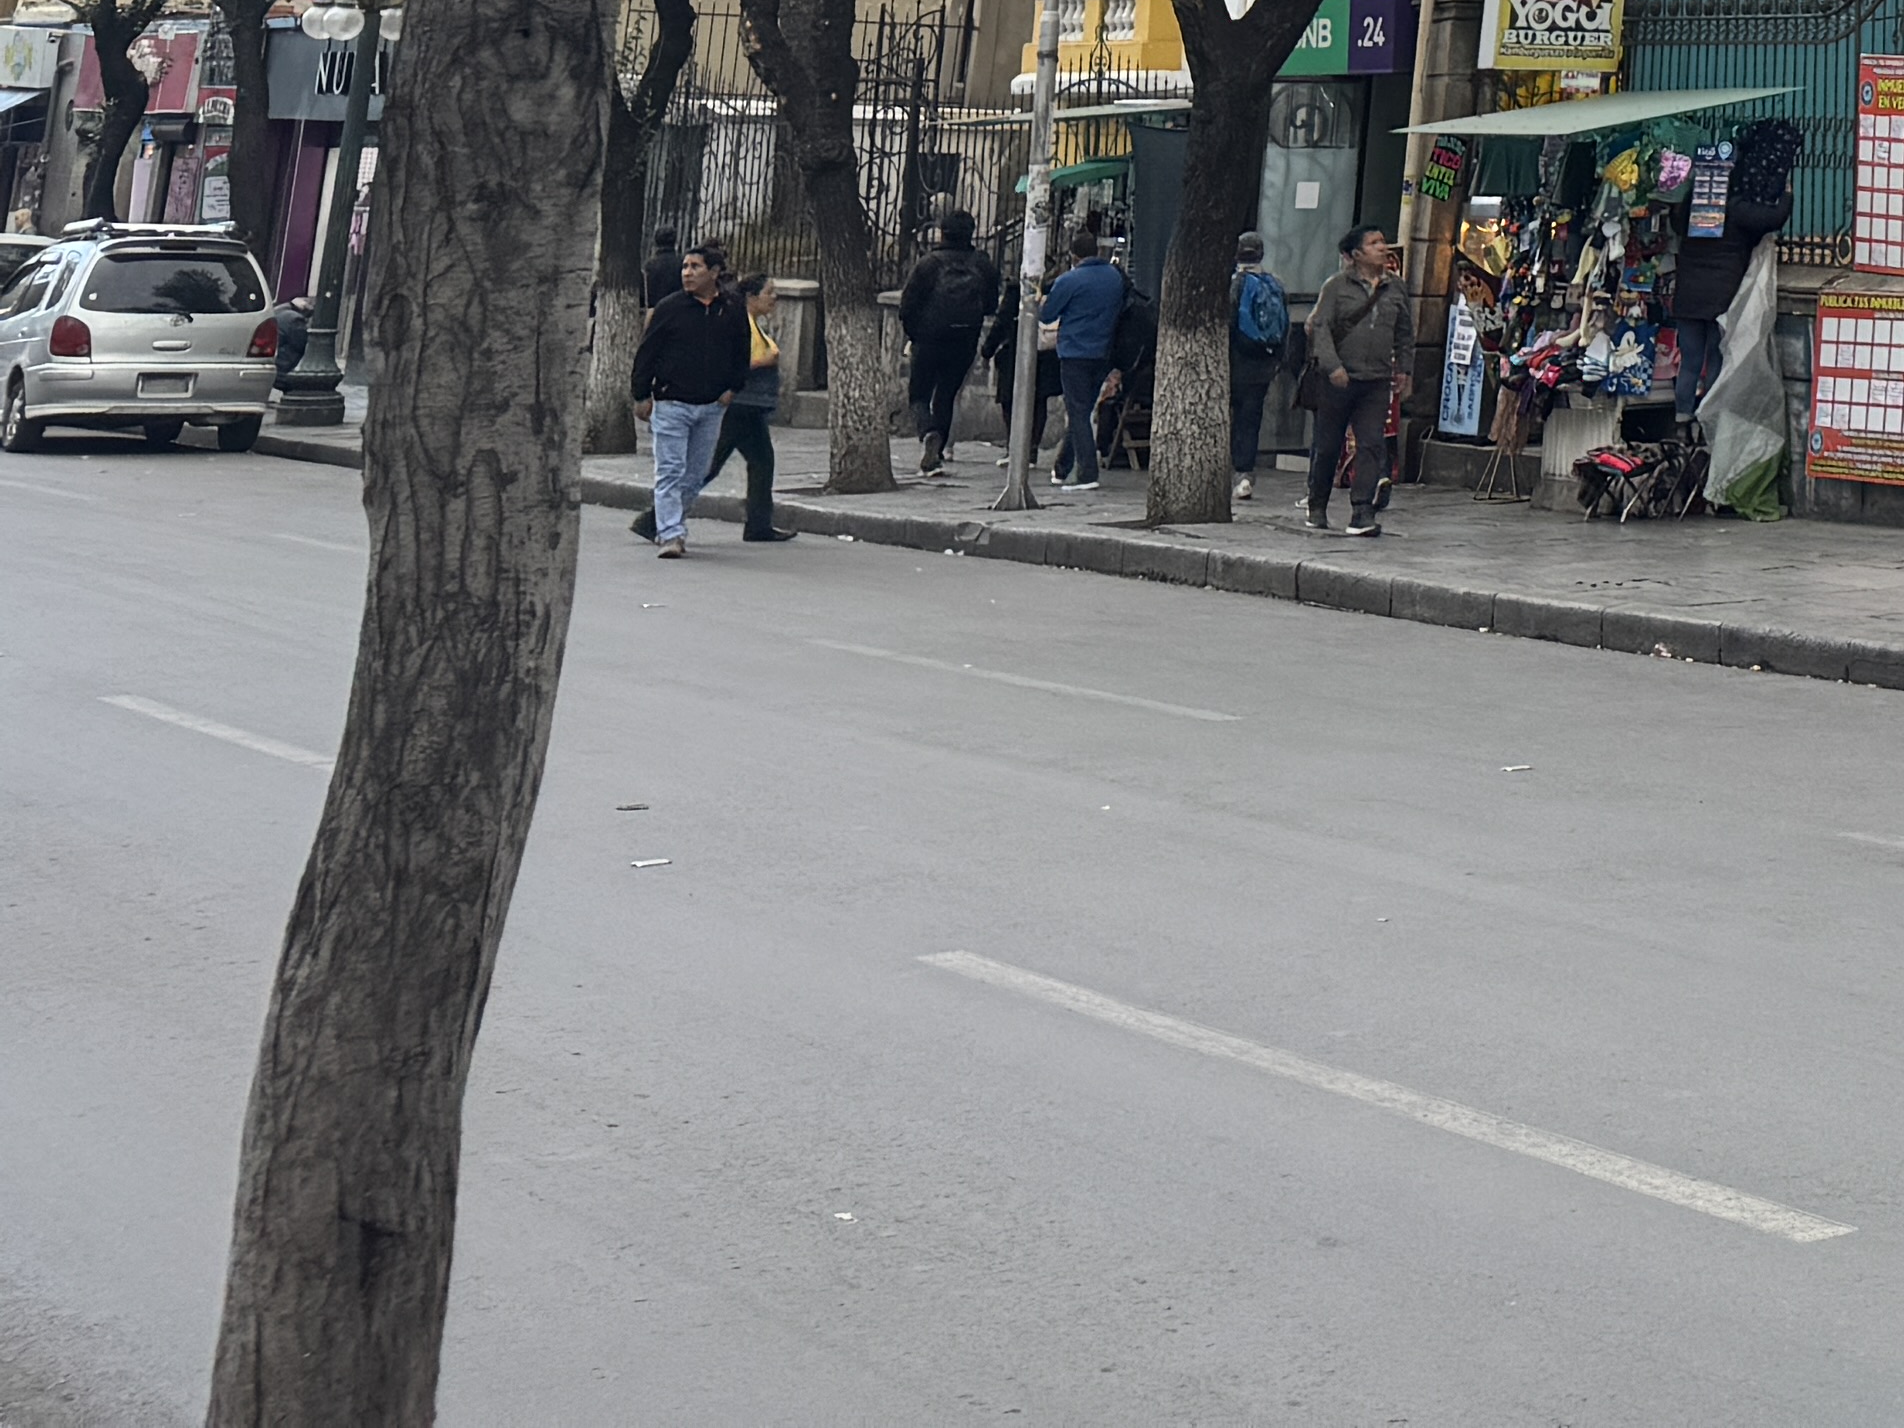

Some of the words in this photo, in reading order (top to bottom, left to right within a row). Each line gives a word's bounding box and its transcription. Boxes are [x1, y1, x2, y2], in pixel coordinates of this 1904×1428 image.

[1295, 17, 1332, 48] NB
[1358, 17, 1385, 47] .24
[1503, 29, 1613, 46] BURGUER
[1878, 95, 1890, 108] EN
